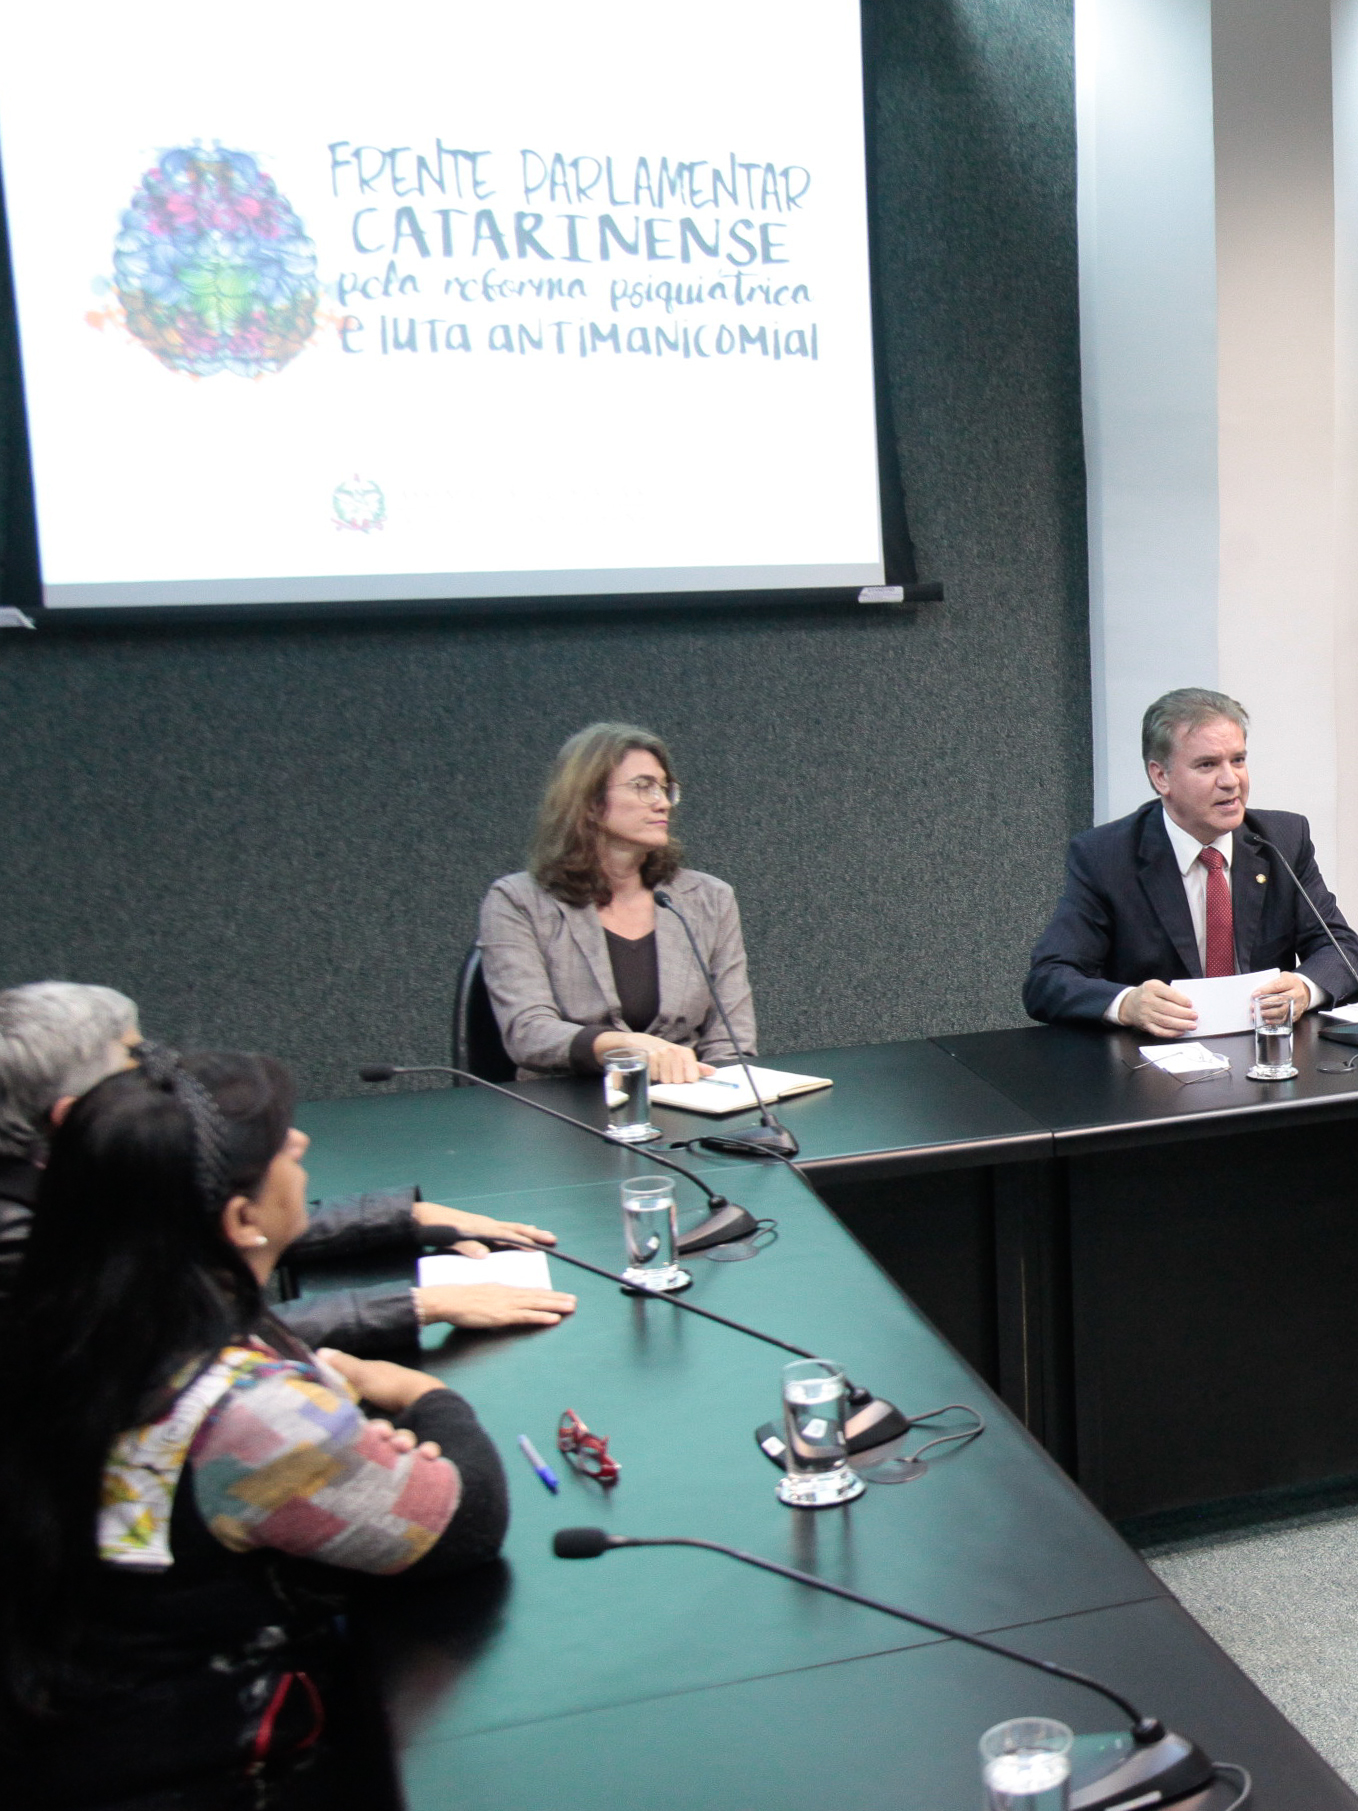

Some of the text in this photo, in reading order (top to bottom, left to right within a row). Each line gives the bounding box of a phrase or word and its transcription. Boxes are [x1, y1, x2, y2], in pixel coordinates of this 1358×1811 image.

[328, 138, 811, 213] FRENTE PARLAMENTAR
[352, 206, 791, 268] CATARINENSE
[338, 260, 815, 315] pela reforma psiquiátrica
